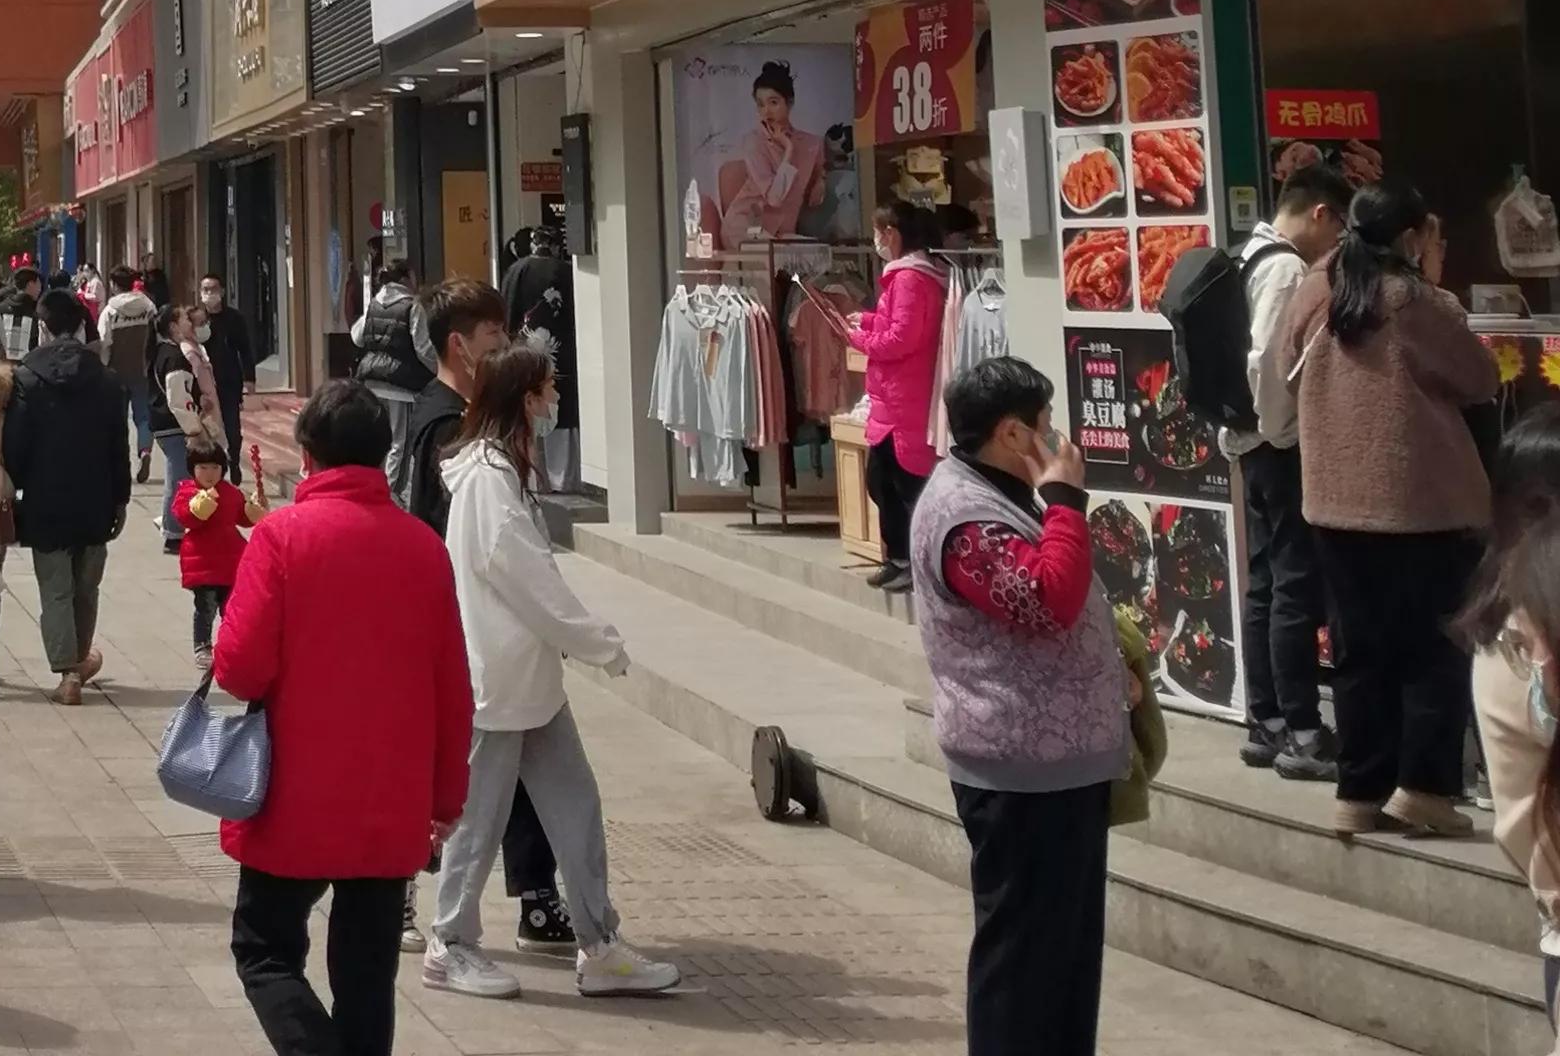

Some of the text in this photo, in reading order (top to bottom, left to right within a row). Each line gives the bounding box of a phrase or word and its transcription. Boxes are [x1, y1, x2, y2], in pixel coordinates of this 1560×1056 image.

[919, 21, 949, 54] 两件
[1278, 99, 1369, 127] 无骨鸡爪
[1082, 400, 1127, 429] 臭豆腐
